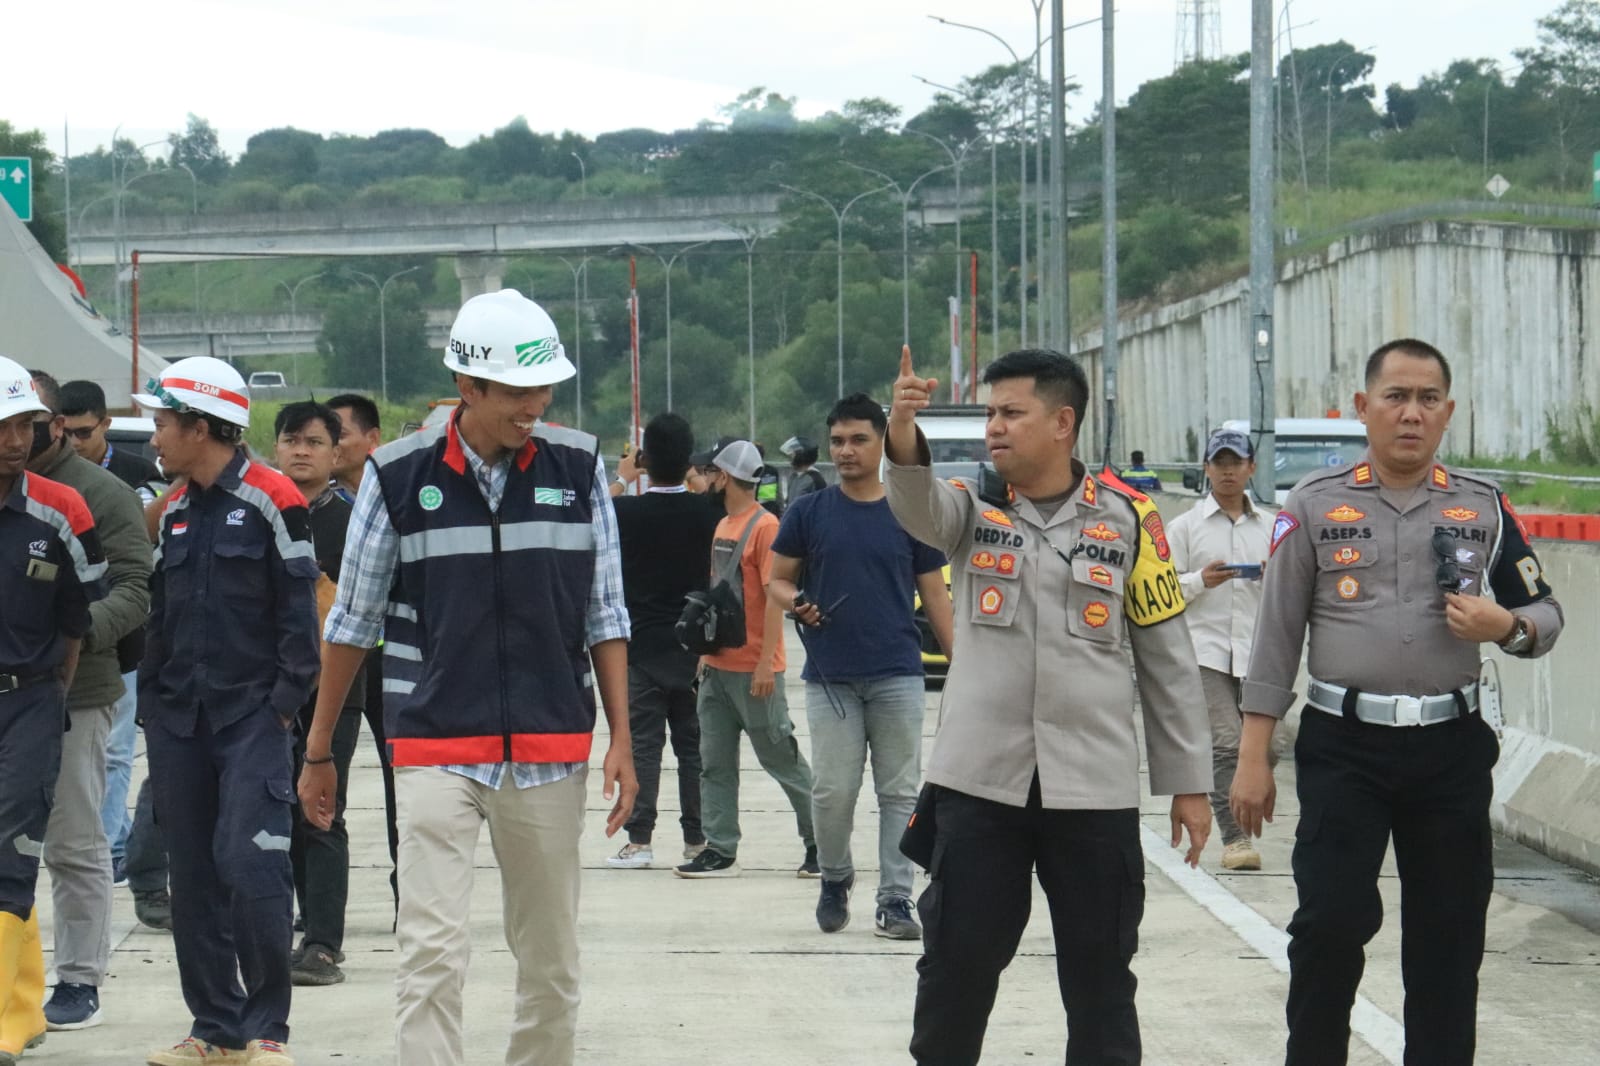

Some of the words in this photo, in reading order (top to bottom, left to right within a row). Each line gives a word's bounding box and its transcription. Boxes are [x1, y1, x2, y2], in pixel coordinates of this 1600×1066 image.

[193, 382, 220, 397] SOM
[974, 526, 1024, 548] DEDY.D
[1319, 527, 1372, 541] ASEP.S
[1072, 543, 1126, 567] POLRI
[1126, 566, 1185, 621] KAOP
